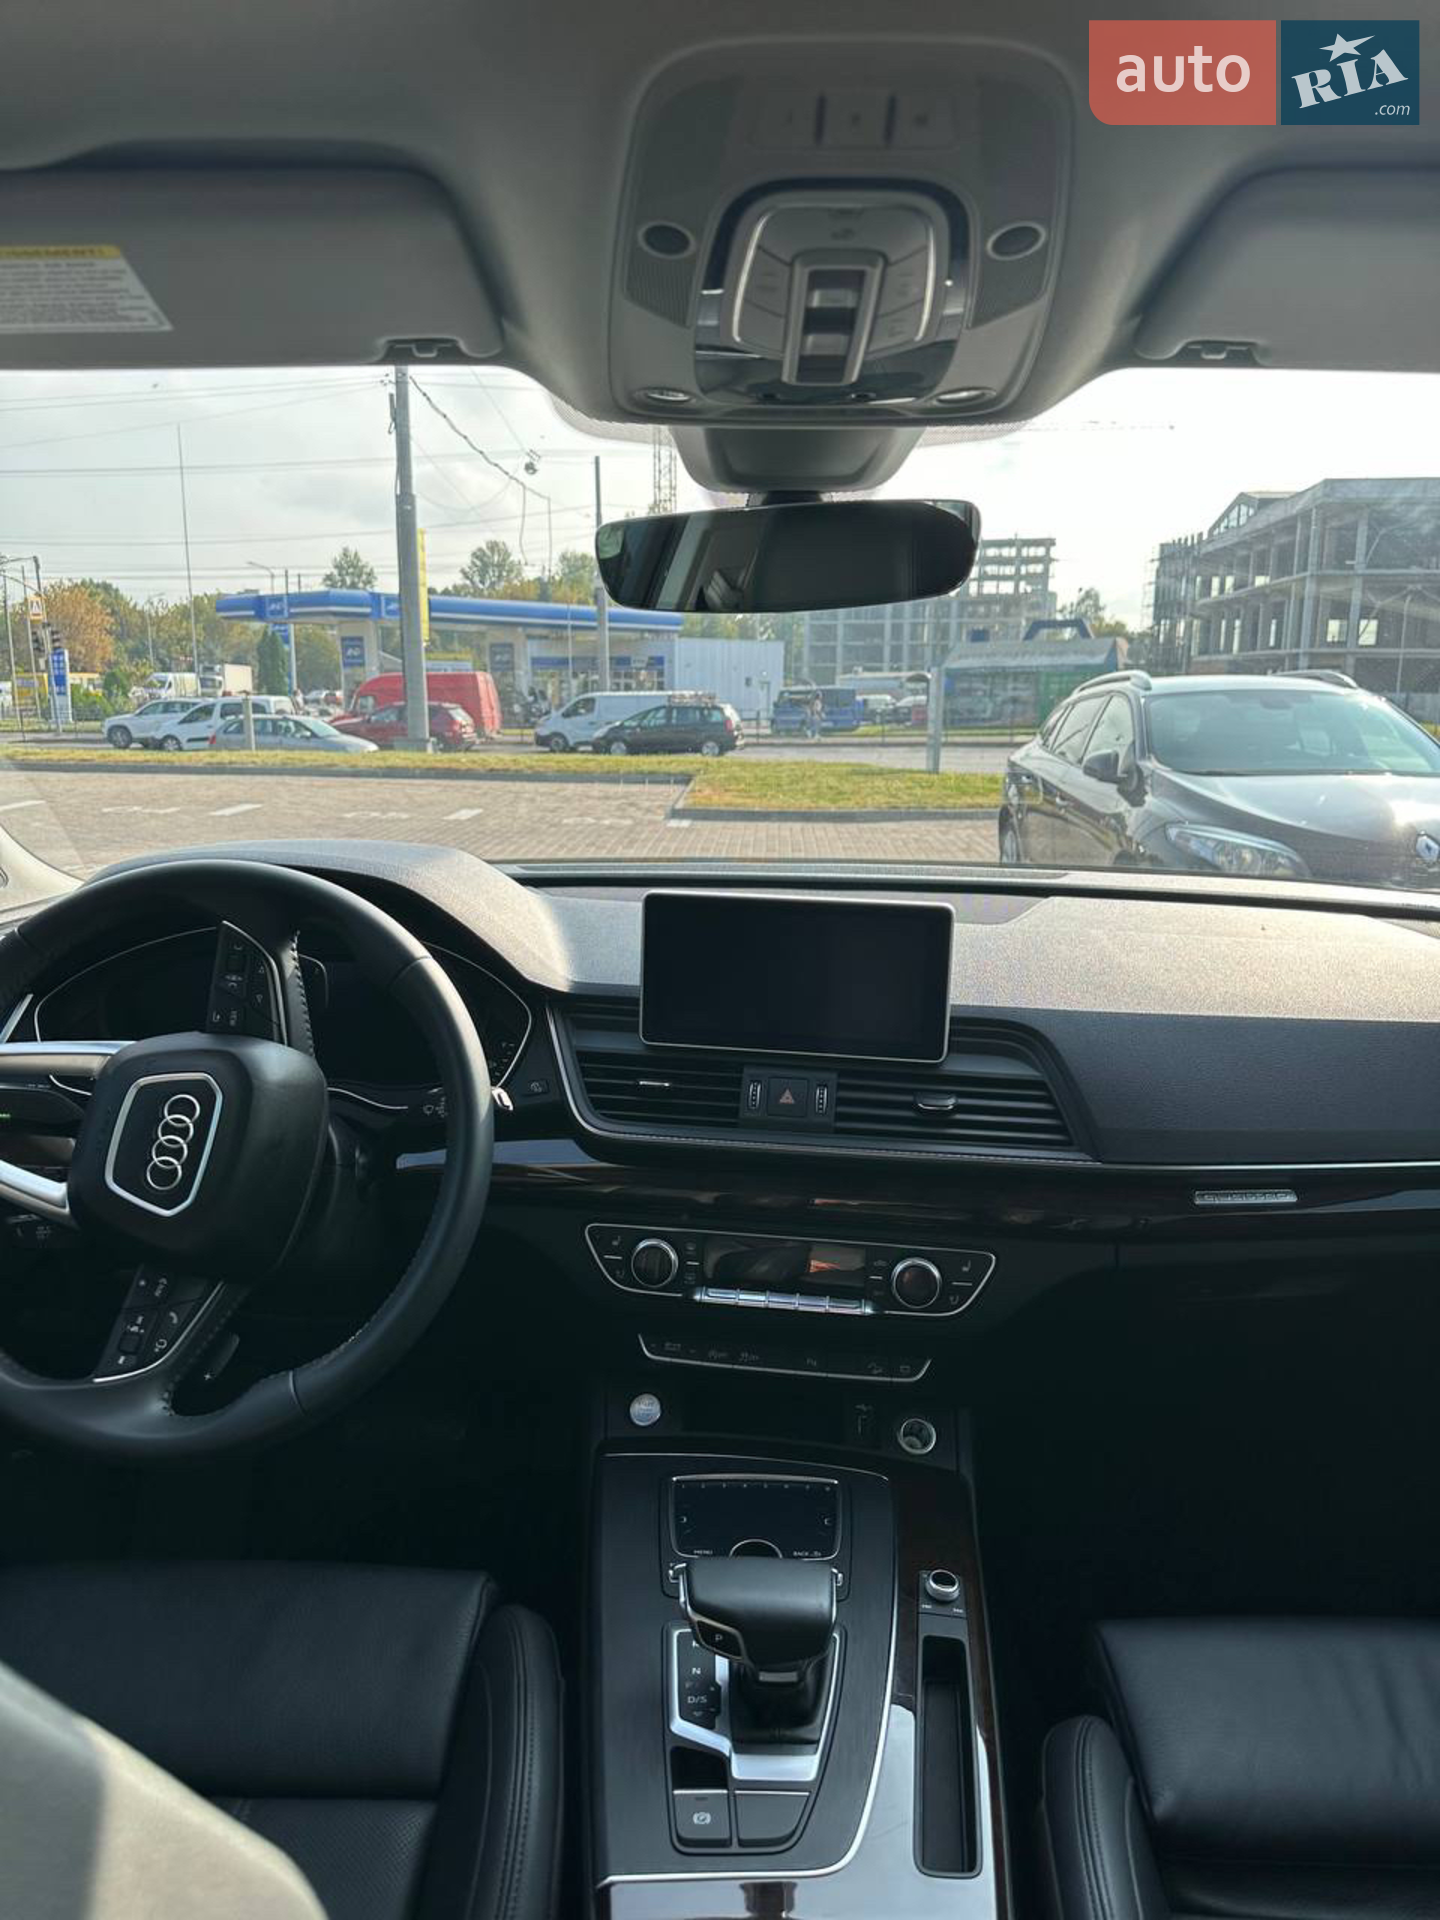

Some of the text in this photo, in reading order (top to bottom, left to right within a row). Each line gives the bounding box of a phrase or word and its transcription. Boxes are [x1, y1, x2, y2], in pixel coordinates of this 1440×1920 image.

[715, 1633, 723, 1642] P
[692, 1667, 702, 1675] N
[687, 1695, 708, 1704] D/S
